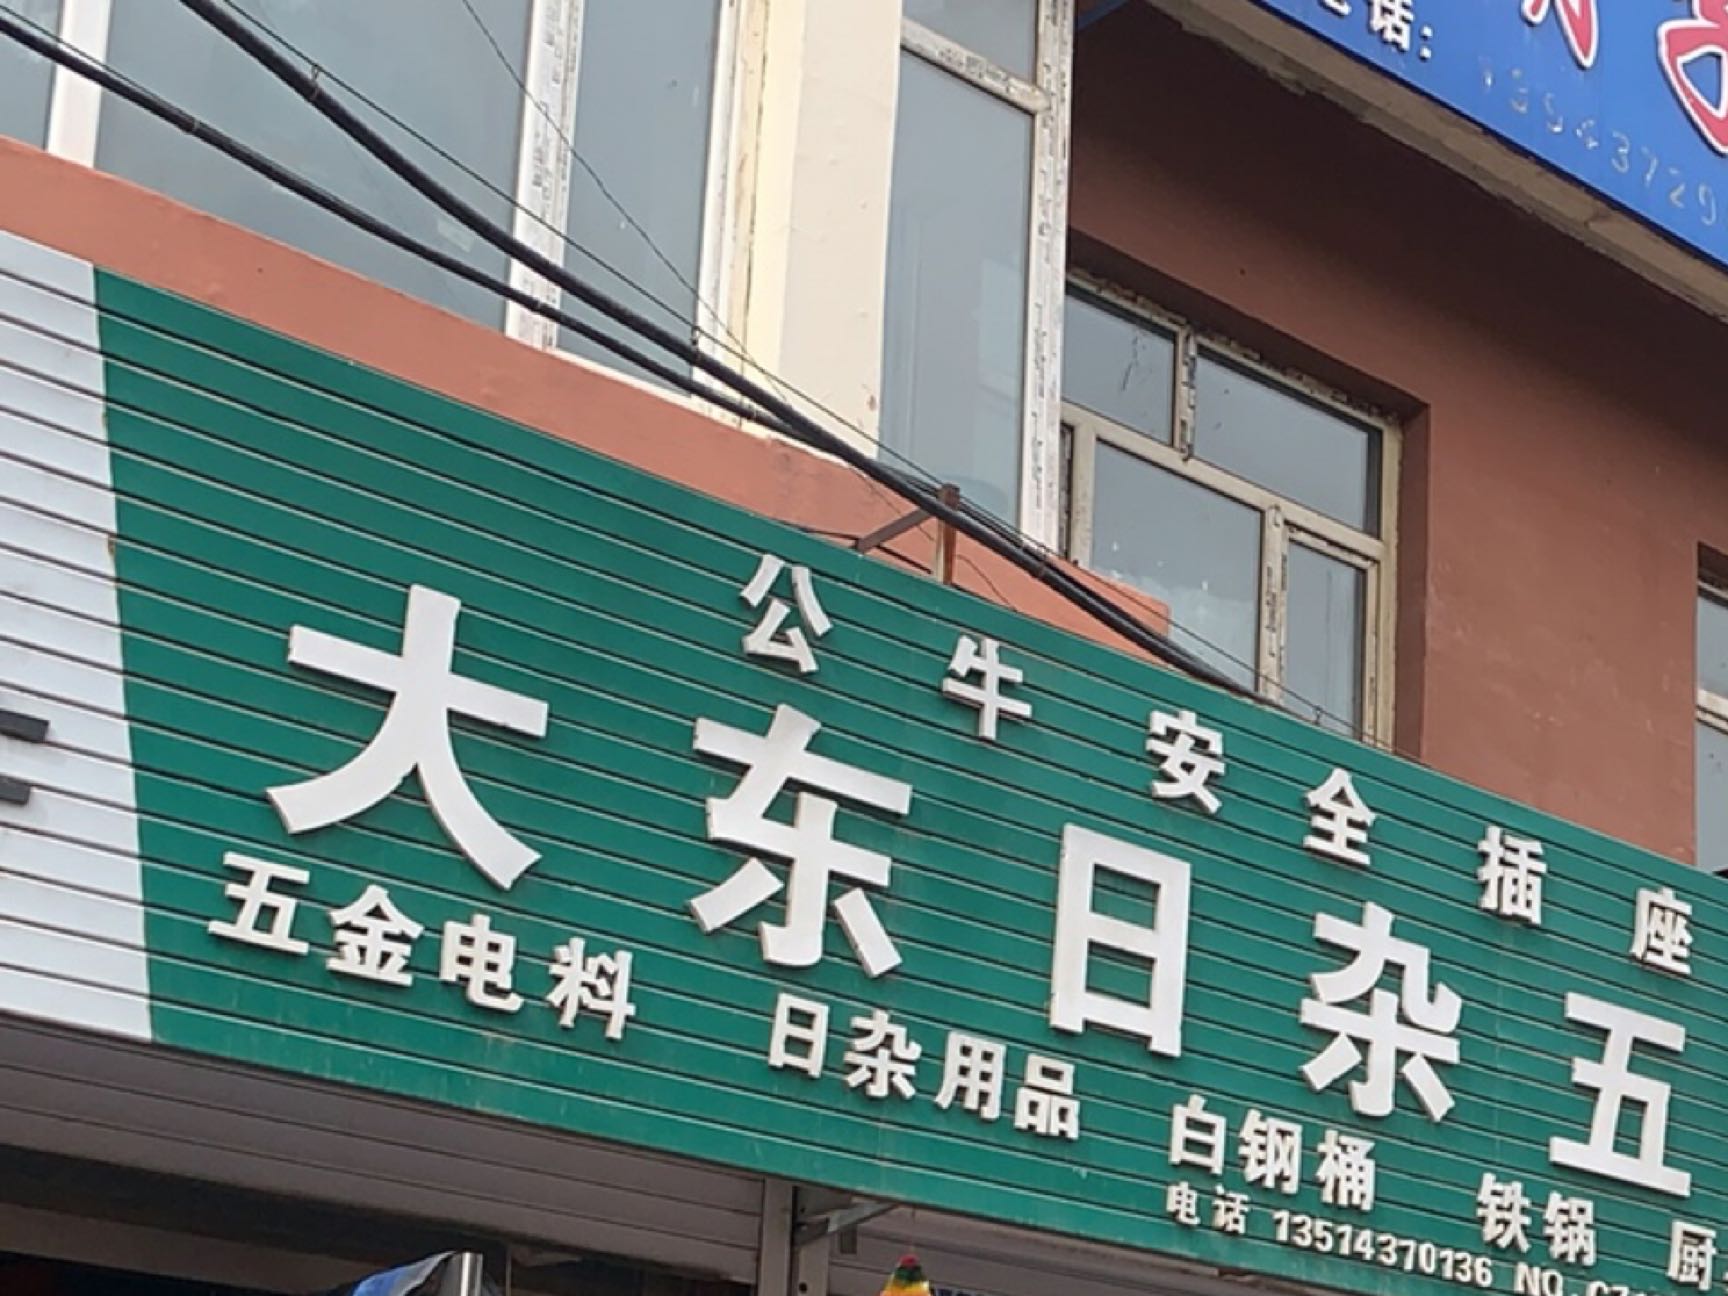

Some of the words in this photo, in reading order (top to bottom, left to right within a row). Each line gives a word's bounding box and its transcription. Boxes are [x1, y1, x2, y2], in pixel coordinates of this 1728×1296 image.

[741, 553, 1694, 977] 公牛安全插座
[208, 851, 637, 1041] 五金电料
[767, 992, 1081, 1142] 日杂用品
[1168, 1094, 1377, 1212] 白钢桶
[1476, 1172, 1597, 1267] 铁锅
[1166, 1180, 1249, 1235] 电话
[1272, 1209, 1493, 1287] 13514370136
